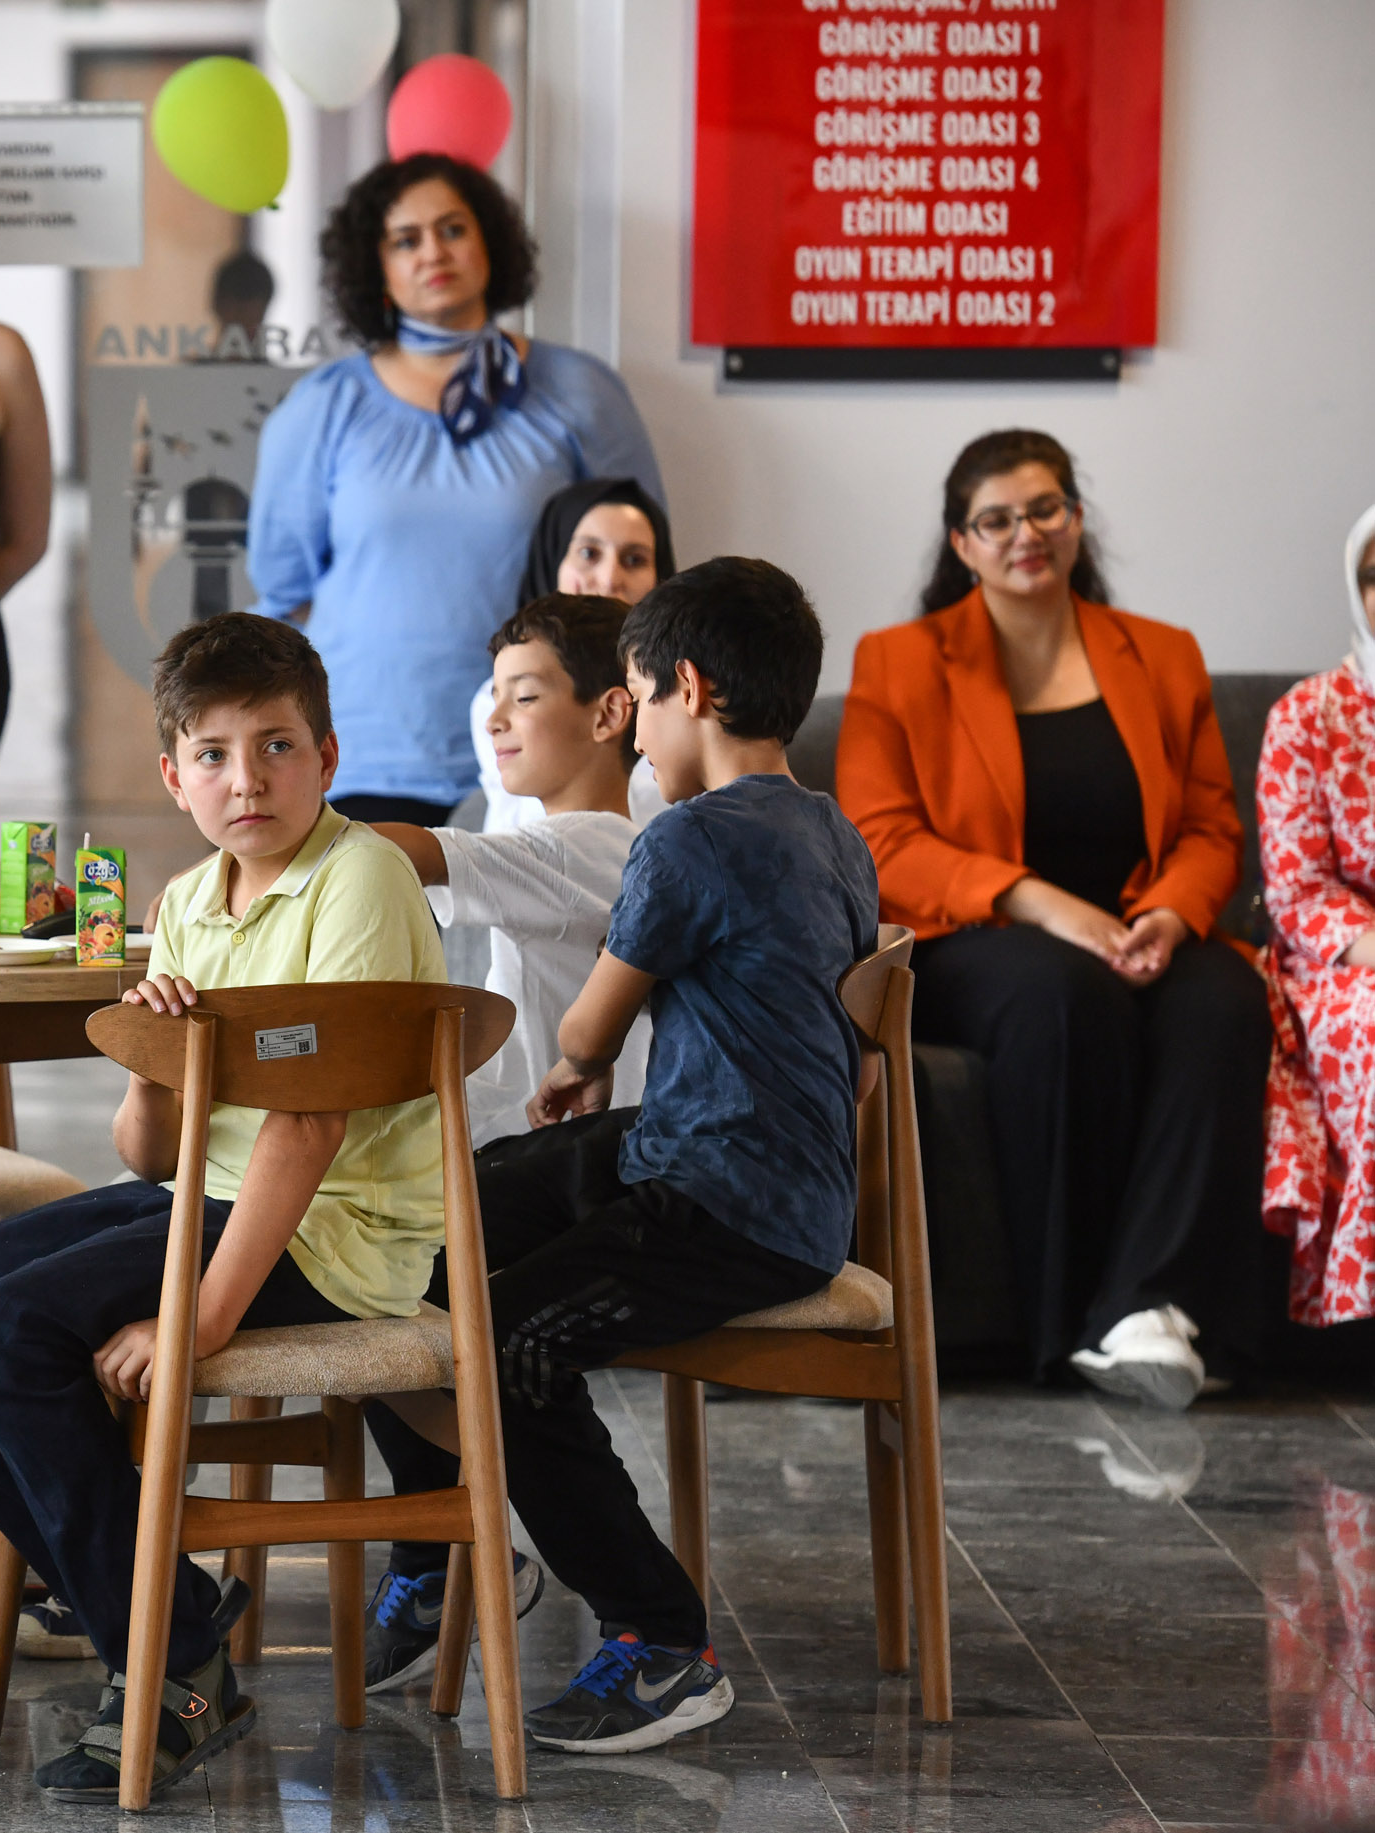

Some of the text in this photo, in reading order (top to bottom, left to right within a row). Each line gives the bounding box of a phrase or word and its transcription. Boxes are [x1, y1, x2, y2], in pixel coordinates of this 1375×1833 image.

[819, 17, 1041, 60] GÖRÜŞME ODASI 1
[816, 62, 1043, 106] GÖRÜŞME ODASI 2
[815, 108, 1041, 151] GÖRÜŞME ODASI 3
[814, 152, 1040, 196] GÖRÜŞME ODASI 4
[842, 197, 1010, 238] EĞİTİM ODASI
[795, 242, 1054, 281] OYUN TERAPİ ODASI 1
[792, 287, 1057, 327] OYUN TERAPİ ODASI 2
[96, 324, 329, 358] ANKARA
